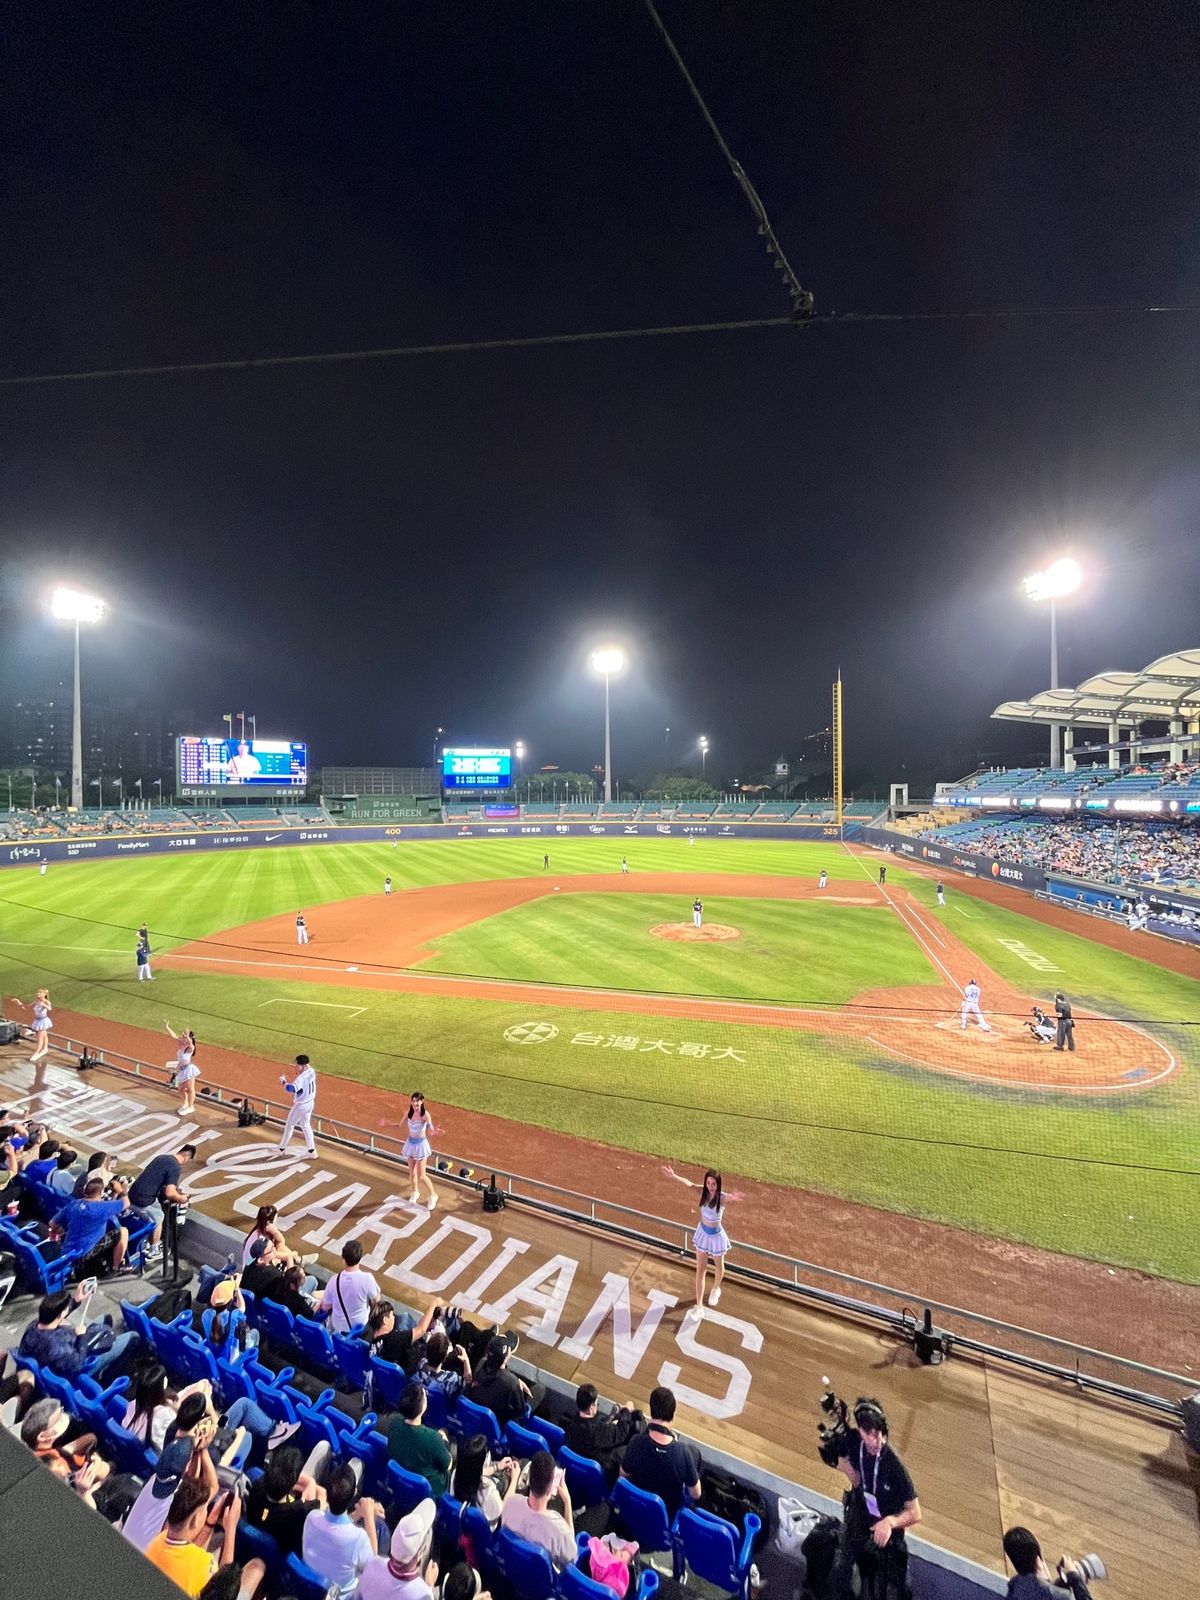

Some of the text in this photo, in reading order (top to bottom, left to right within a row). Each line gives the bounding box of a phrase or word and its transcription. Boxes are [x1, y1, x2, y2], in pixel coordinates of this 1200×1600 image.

[351, 809, 422, 818] RUN FOR GREEN
[117, 841, 150, 849] FamilyMart
[570, 1031, 747, 1063] 台灣大哥大
[308, 1080, 315, 1095] 11
[177, 1142, 763, 1420] GUARDIANS
